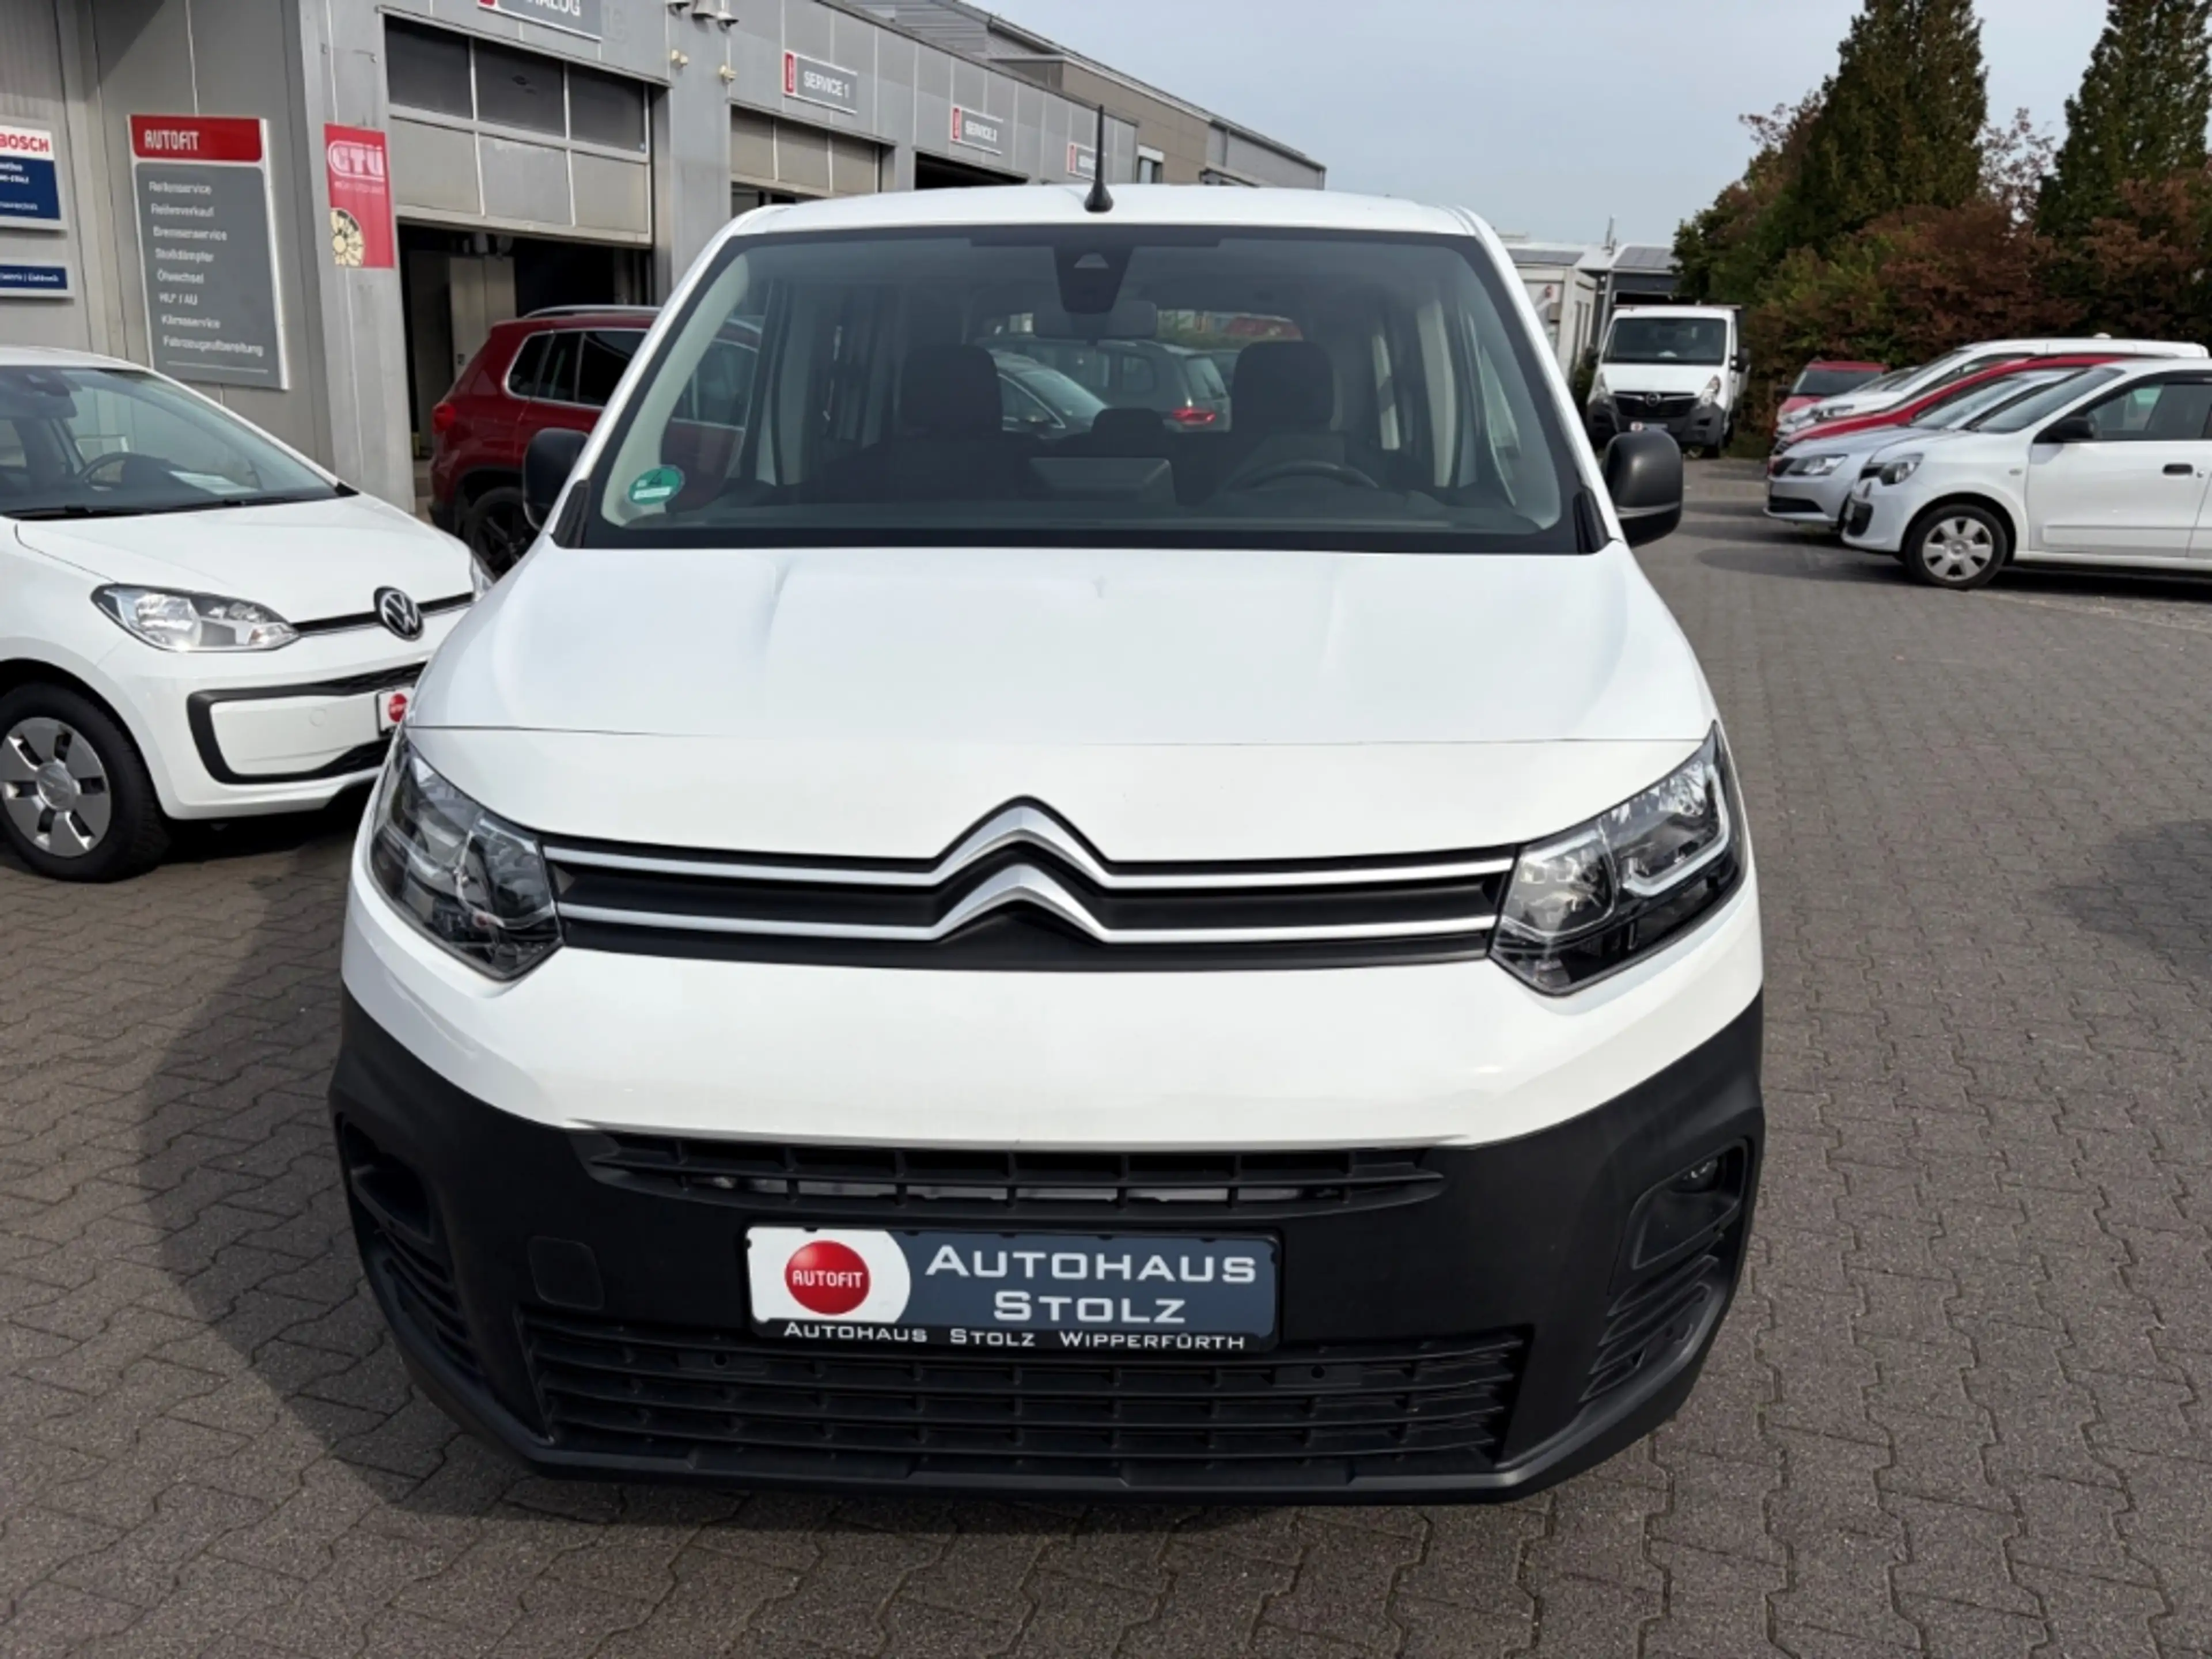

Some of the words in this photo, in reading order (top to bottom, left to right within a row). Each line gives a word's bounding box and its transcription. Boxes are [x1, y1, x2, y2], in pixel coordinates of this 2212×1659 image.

[804, 70, 843, 96] SERVICE
[844, 83, 850, 99] 1
[0, 134, 49, 152] BOSCH
[145, 129, 199, 150] AUTOFIT
[791, 1268, 863, 1289] AUTOFIT
[925, 1244, 1257, 1284] AUTOHAUS
[993, 1290, 1186, 1324] STOLZ
[783, 1321, 928, 1343] AUTOHAUS
[949, 1328, 1036, 1347] STOLZ
[1059, 1331, 1245, 1350] WIPPERFÜRTH
